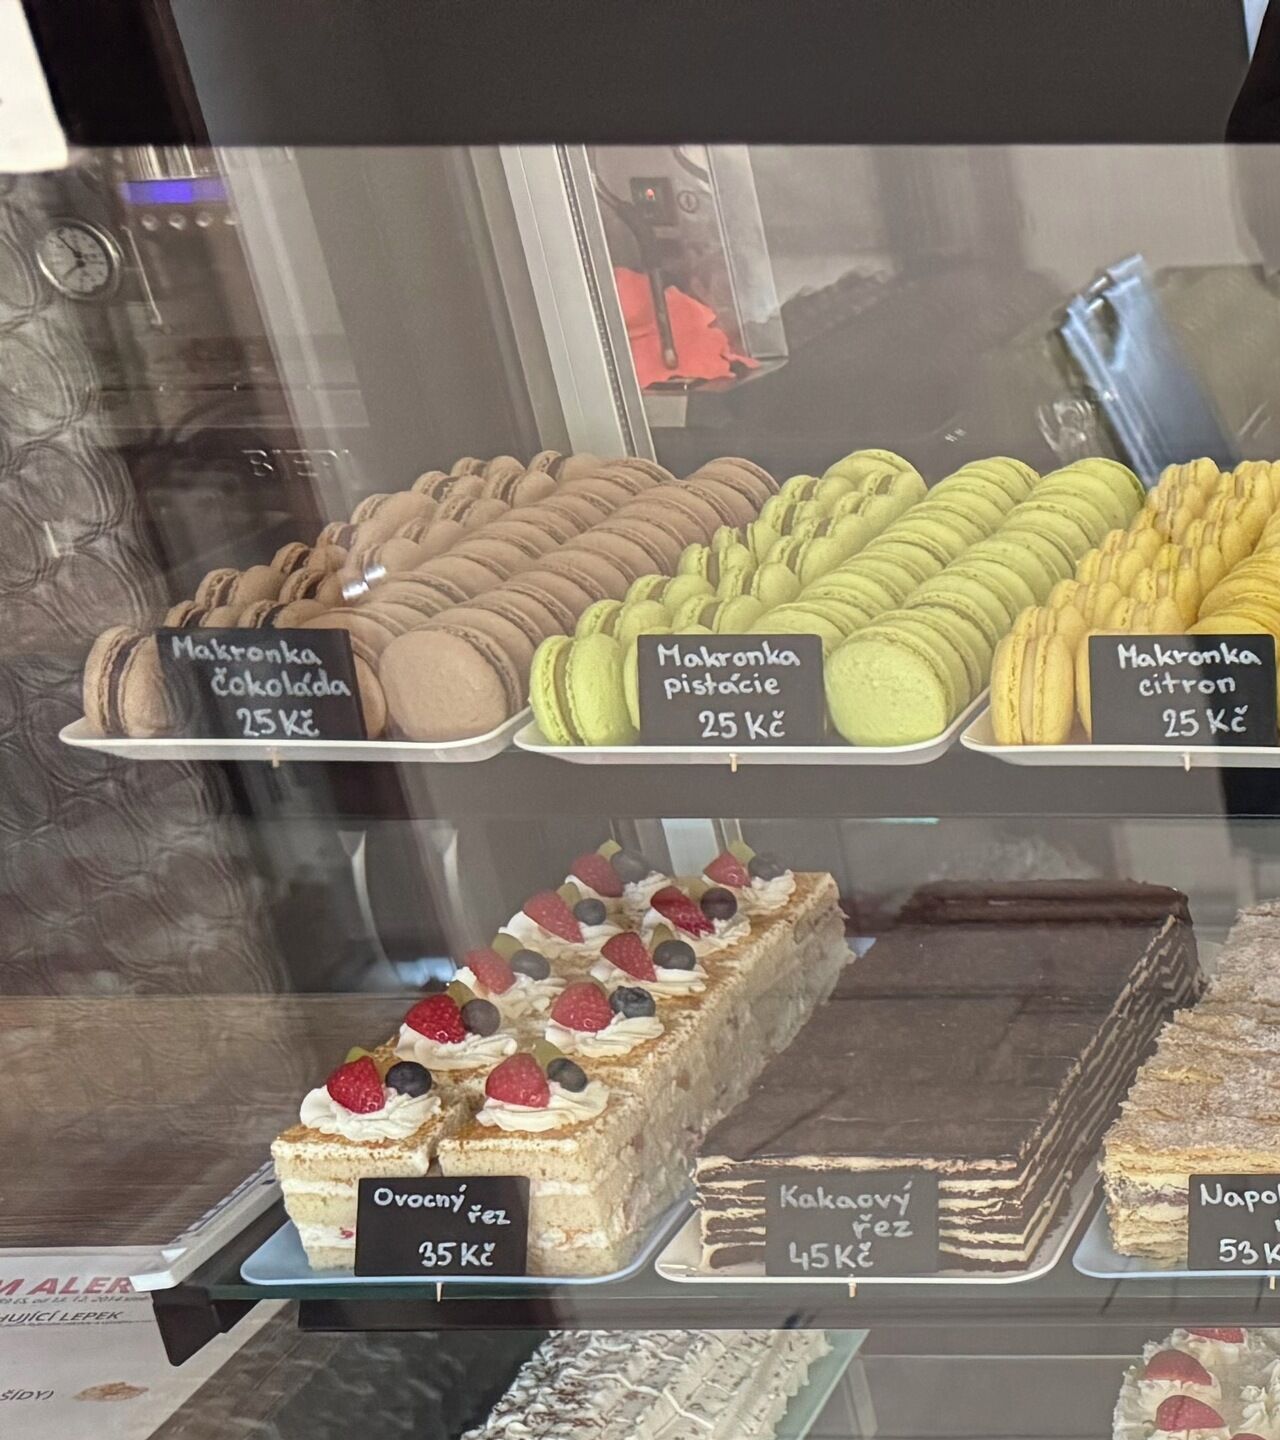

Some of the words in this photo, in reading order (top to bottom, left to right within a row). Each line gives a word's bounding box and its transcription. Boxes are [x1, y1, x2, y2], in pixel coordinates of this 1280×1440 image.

[171, 635, 323, 667] Makronka
[656, 640, 801, 668] Makronka
[1116, 641, 1263, 670] Makronka
[210, 666, 352, 698] čokoláda
[663, 672, 782, 701] pistácie
[1138, 671, 1236, 697] citron
[235, 707, 278, 737] 25
[277, 708, 321, 738] Kč
[698, 710, 739, 739] 25
[744, 709, 786, 741] Kč
[1161, 707, 1200, 738] 25
[1205, 704, 1249, 735] Kč
[373, 1183, 468, 1214] Ovocný
[779, 1180, 913, 1216] Kakaový
[466, 1203, 512, 1226] řez
[851, 1213, 914, 1240] řez
[418, 1241, 458, 1268] 35
[459, 1241, 497, 1268] Kč
[788, 1241, 830, 1271] 45
[834, 1241, 874, 1270] Kč
[1218, 1238, 1260, 1266] 53
[25, 1276, 135, 1296] ALER
[59, 1311, 123, 1322] LEPEK
